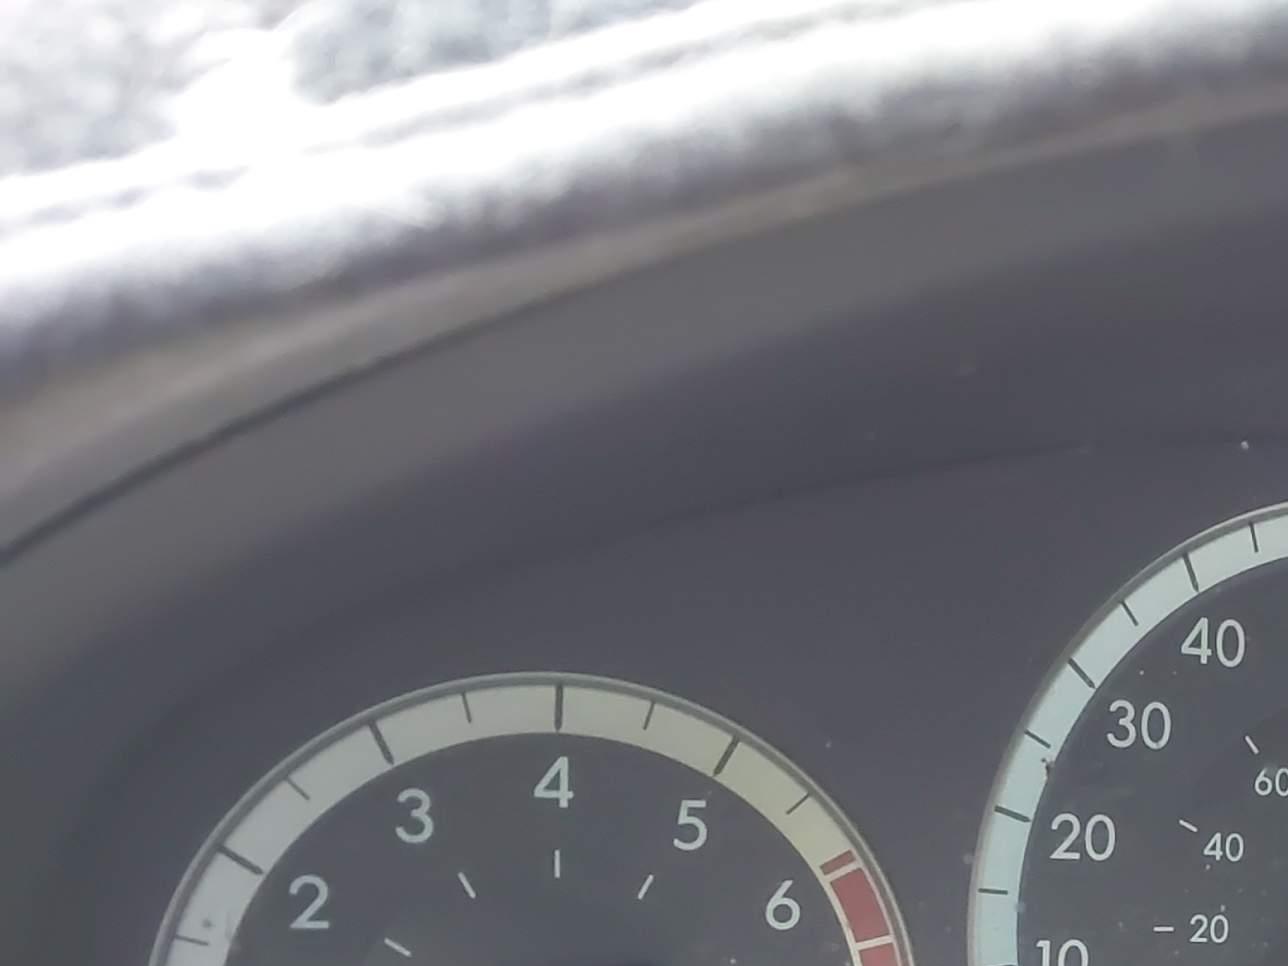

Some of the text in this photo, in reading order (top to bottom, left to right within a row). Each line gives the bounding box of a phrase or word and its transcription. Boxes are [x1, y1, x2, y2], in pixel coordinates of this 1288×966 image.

[1181, 618, 1246, 668] 40
[1106, 700, 1172, 749] 30
[533, 755, 574, 808] 4
[396, 789, 434, 843] 3
[672, 800, 707, 851] 5
[1050, 812, 1116, 862] 20
[1203, 833, 1244, 862] 40
[290, 874, 330, 930] 2
[765, 879, 800, 930] 6
[1190, 915, 1230, 944] 20
